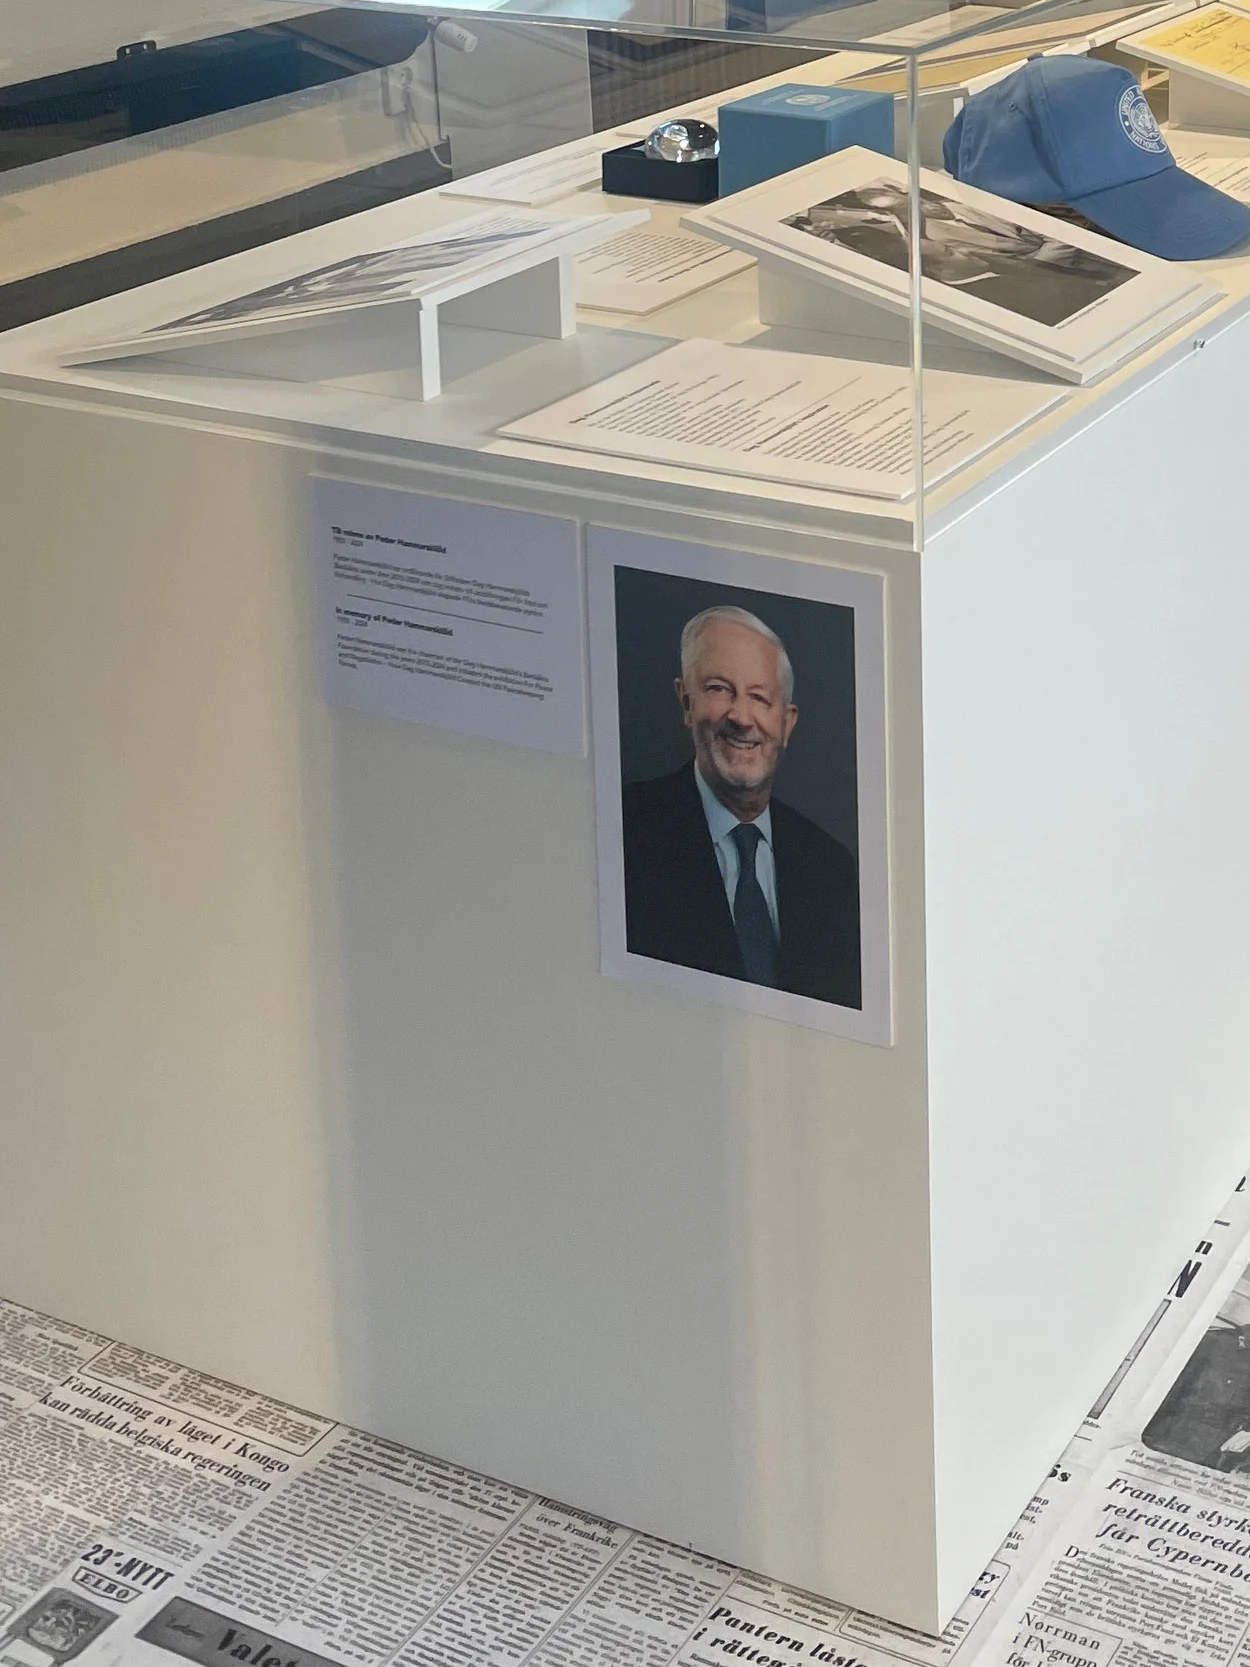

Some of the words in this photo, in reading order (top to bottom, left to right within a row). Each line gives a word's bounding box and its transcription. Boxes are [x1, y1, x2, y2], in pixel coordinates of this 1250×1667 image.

[1121, 91, 1135, 115] UNITED
[1130, 131, 1160, 150] NATIONS
[375, 534, 396, 544] Peter
[344, 609, 371, 622] memory
[382, 615, 402, 626] Peter
[62, 1375, 153, 1422] Förbättring
[154, 1415, 177, 1429] av
[178, 1420, 223, 1447] läget
[222, 1437, 235, 1451] i
[234, 1440, 290, 1474] Kongo
[38, 1392, 72, 1413] kan
[71, 1405, 117, 1431] rädda
[115, 1421, 184, 1457] belgiska
[182, 1450, 272, 1492] regeringen
[1105, 1477, 1191, 1514] Franska
[536, 1513, 561, 1528] över
[563, 1521, 619, 1550] Frankrike
[1095, 1523, 1139, 1545] får
[80, 1573, 131, 1600] ELBO
[692, 1627, 708, 1641] i
[708, 1607, 804, 1652] Pantern
[809, 1643, 868, 1667] låst
[1017, 1612, 1101, 1650] Norrman
